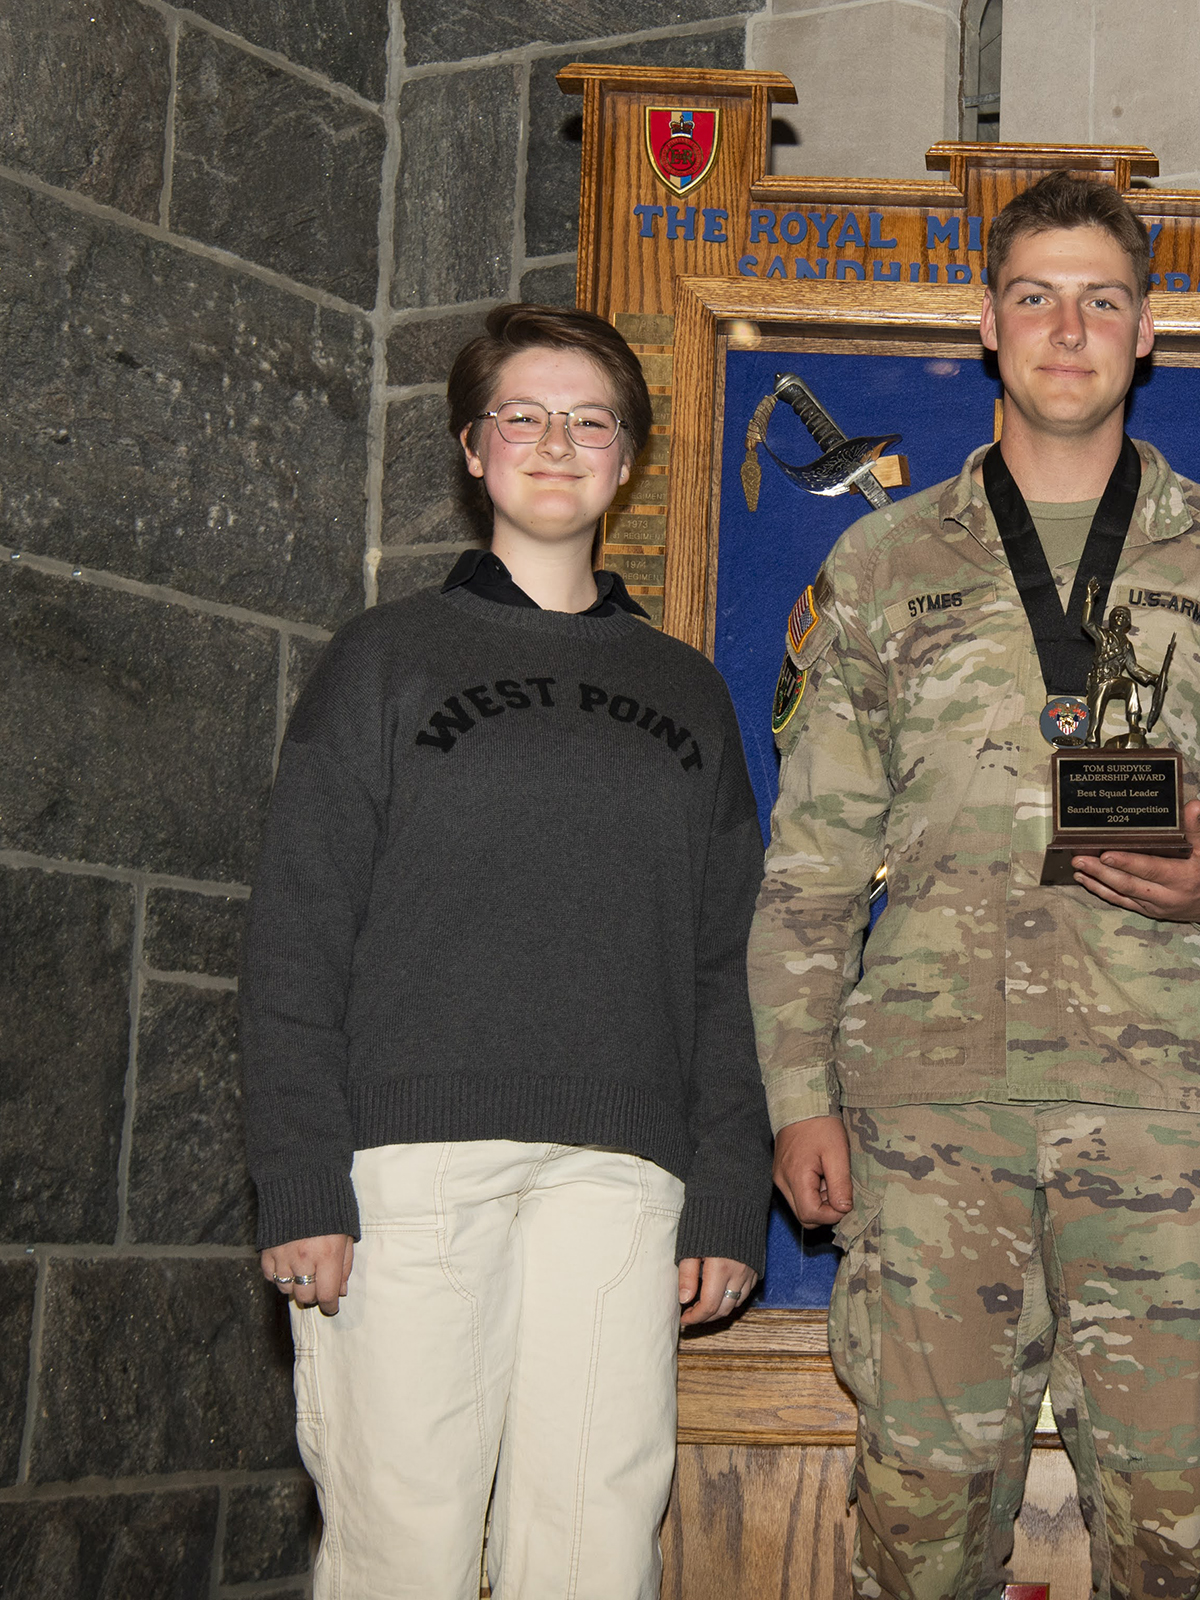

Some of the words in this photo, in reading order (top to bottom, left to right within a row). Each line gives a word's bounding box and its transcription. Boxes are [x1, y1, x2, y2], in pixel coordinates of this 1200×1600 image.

[633, 204, 728, 242] THE
[749, 208, 898, 248] ROYAL
[623, 532, 664, 541] REGIMENT
[907, 591, 963, 618] SYMES
[415, 677, 556, 753] WEST
[578, 683, 703, 772] POINT
[1083, 765, 1105, 773] TOM
[1106, 765, 1152, 773] SURDYKE
[1069, 774, 1129, 782] LEADERSHIP
[1131, 774, 1166, 782] AWARD
[1099, 790, 1127, 799] Squad
[1067, 806, 1114, 814] Sandhurst
[1116, 806, 1169, 815] Competition
[1107, 815, 1130, 823] 2024
